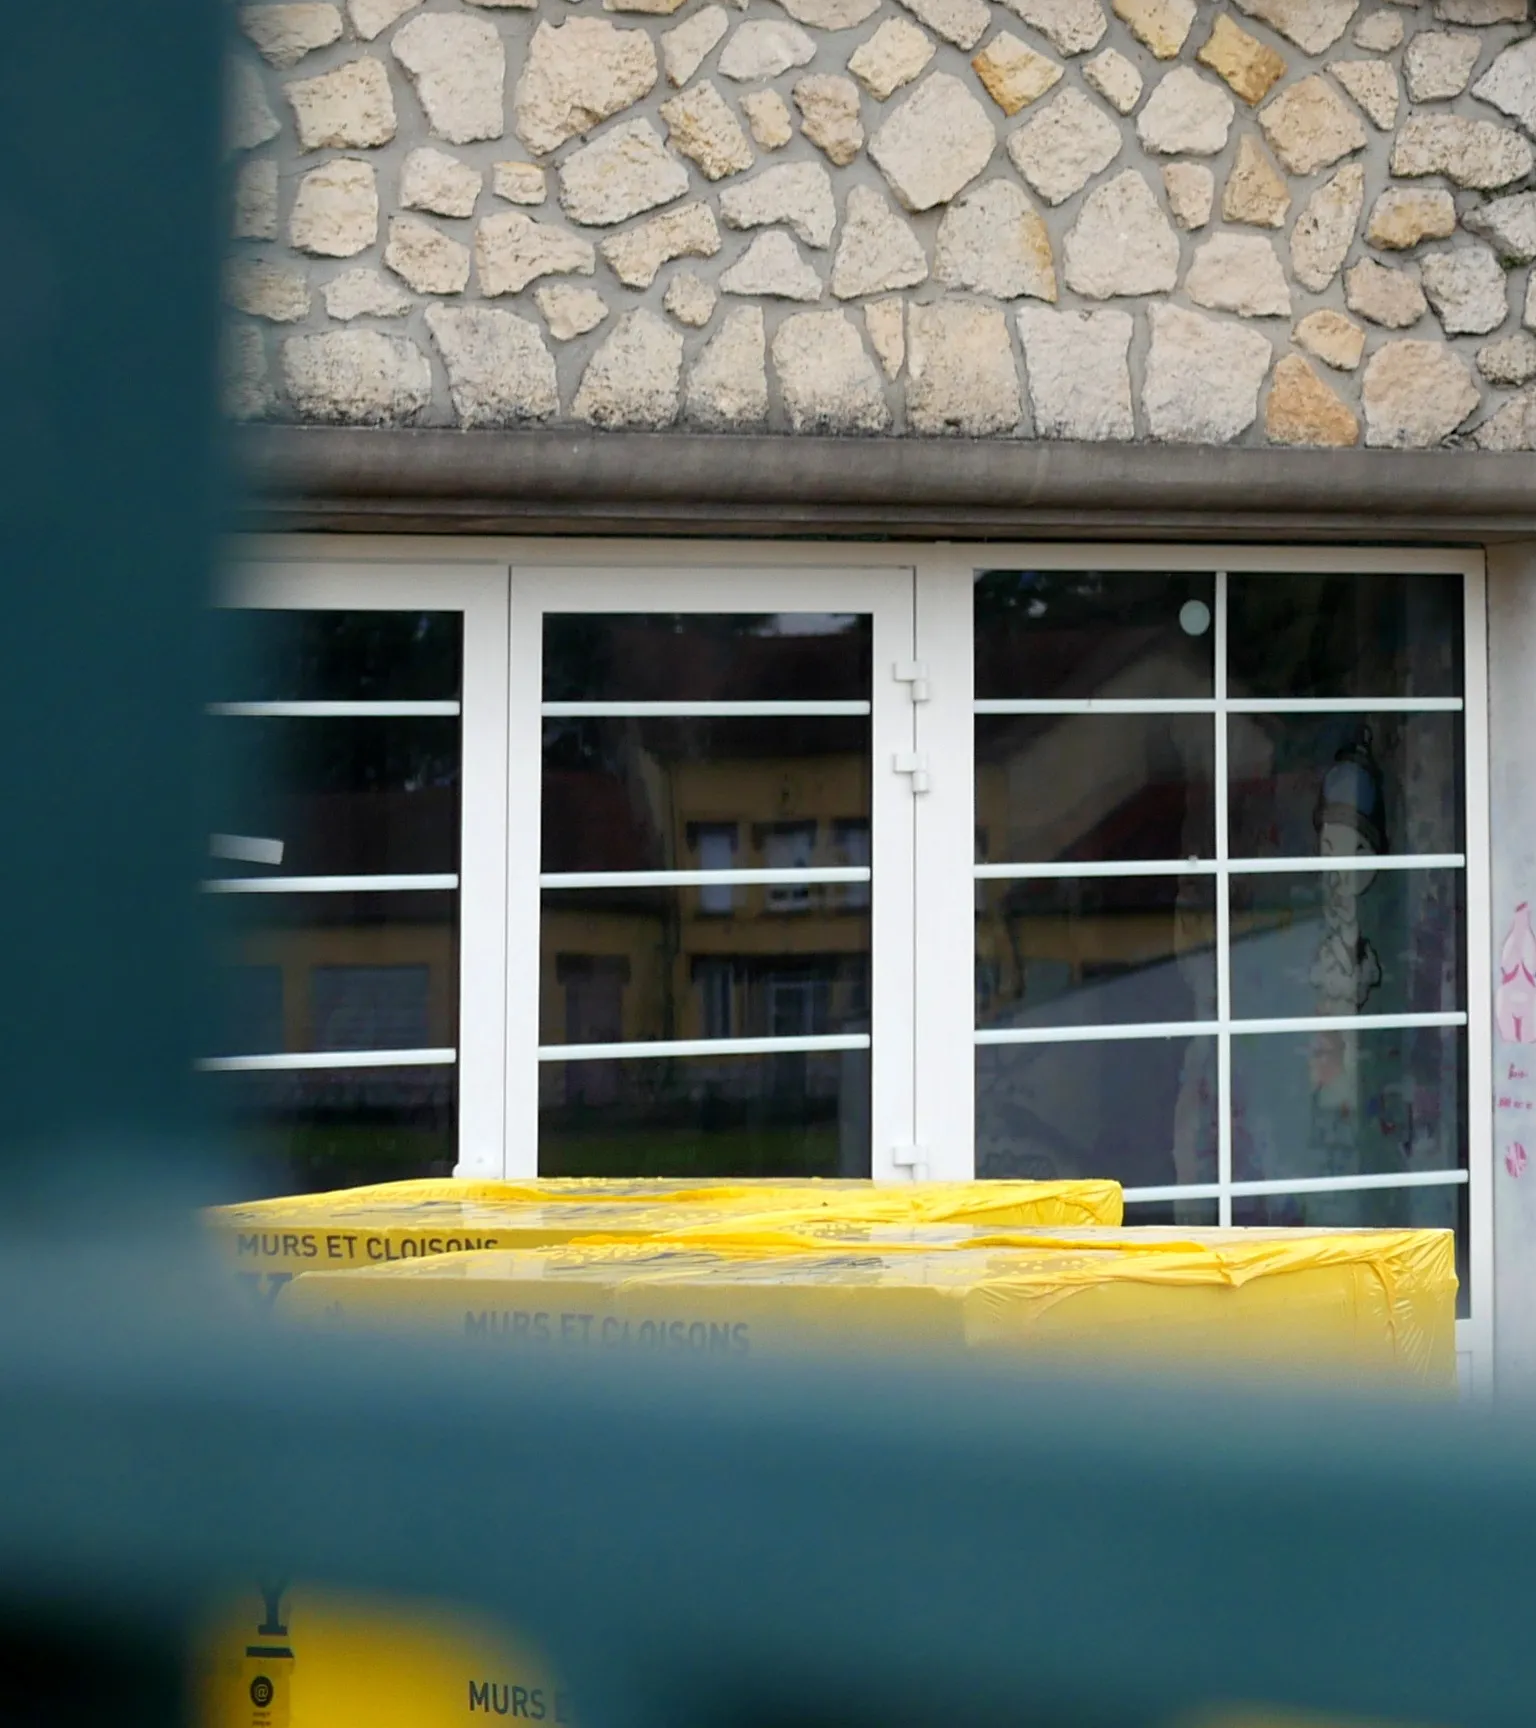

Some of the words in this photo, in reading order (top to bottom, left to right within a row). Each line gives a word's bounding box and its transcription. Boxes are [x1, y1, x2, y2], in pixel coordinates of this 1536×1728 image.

[237, 1233, 318, 1258] MURS
[327, 1235, 356, 1259] ET
[464, 1310, 550, 1342] MURS
[560, 1313, 594, 1347] ET
[601, 1316, 750, 1356] CLOISONS
[468, 1680, 546, 1720] MURS
